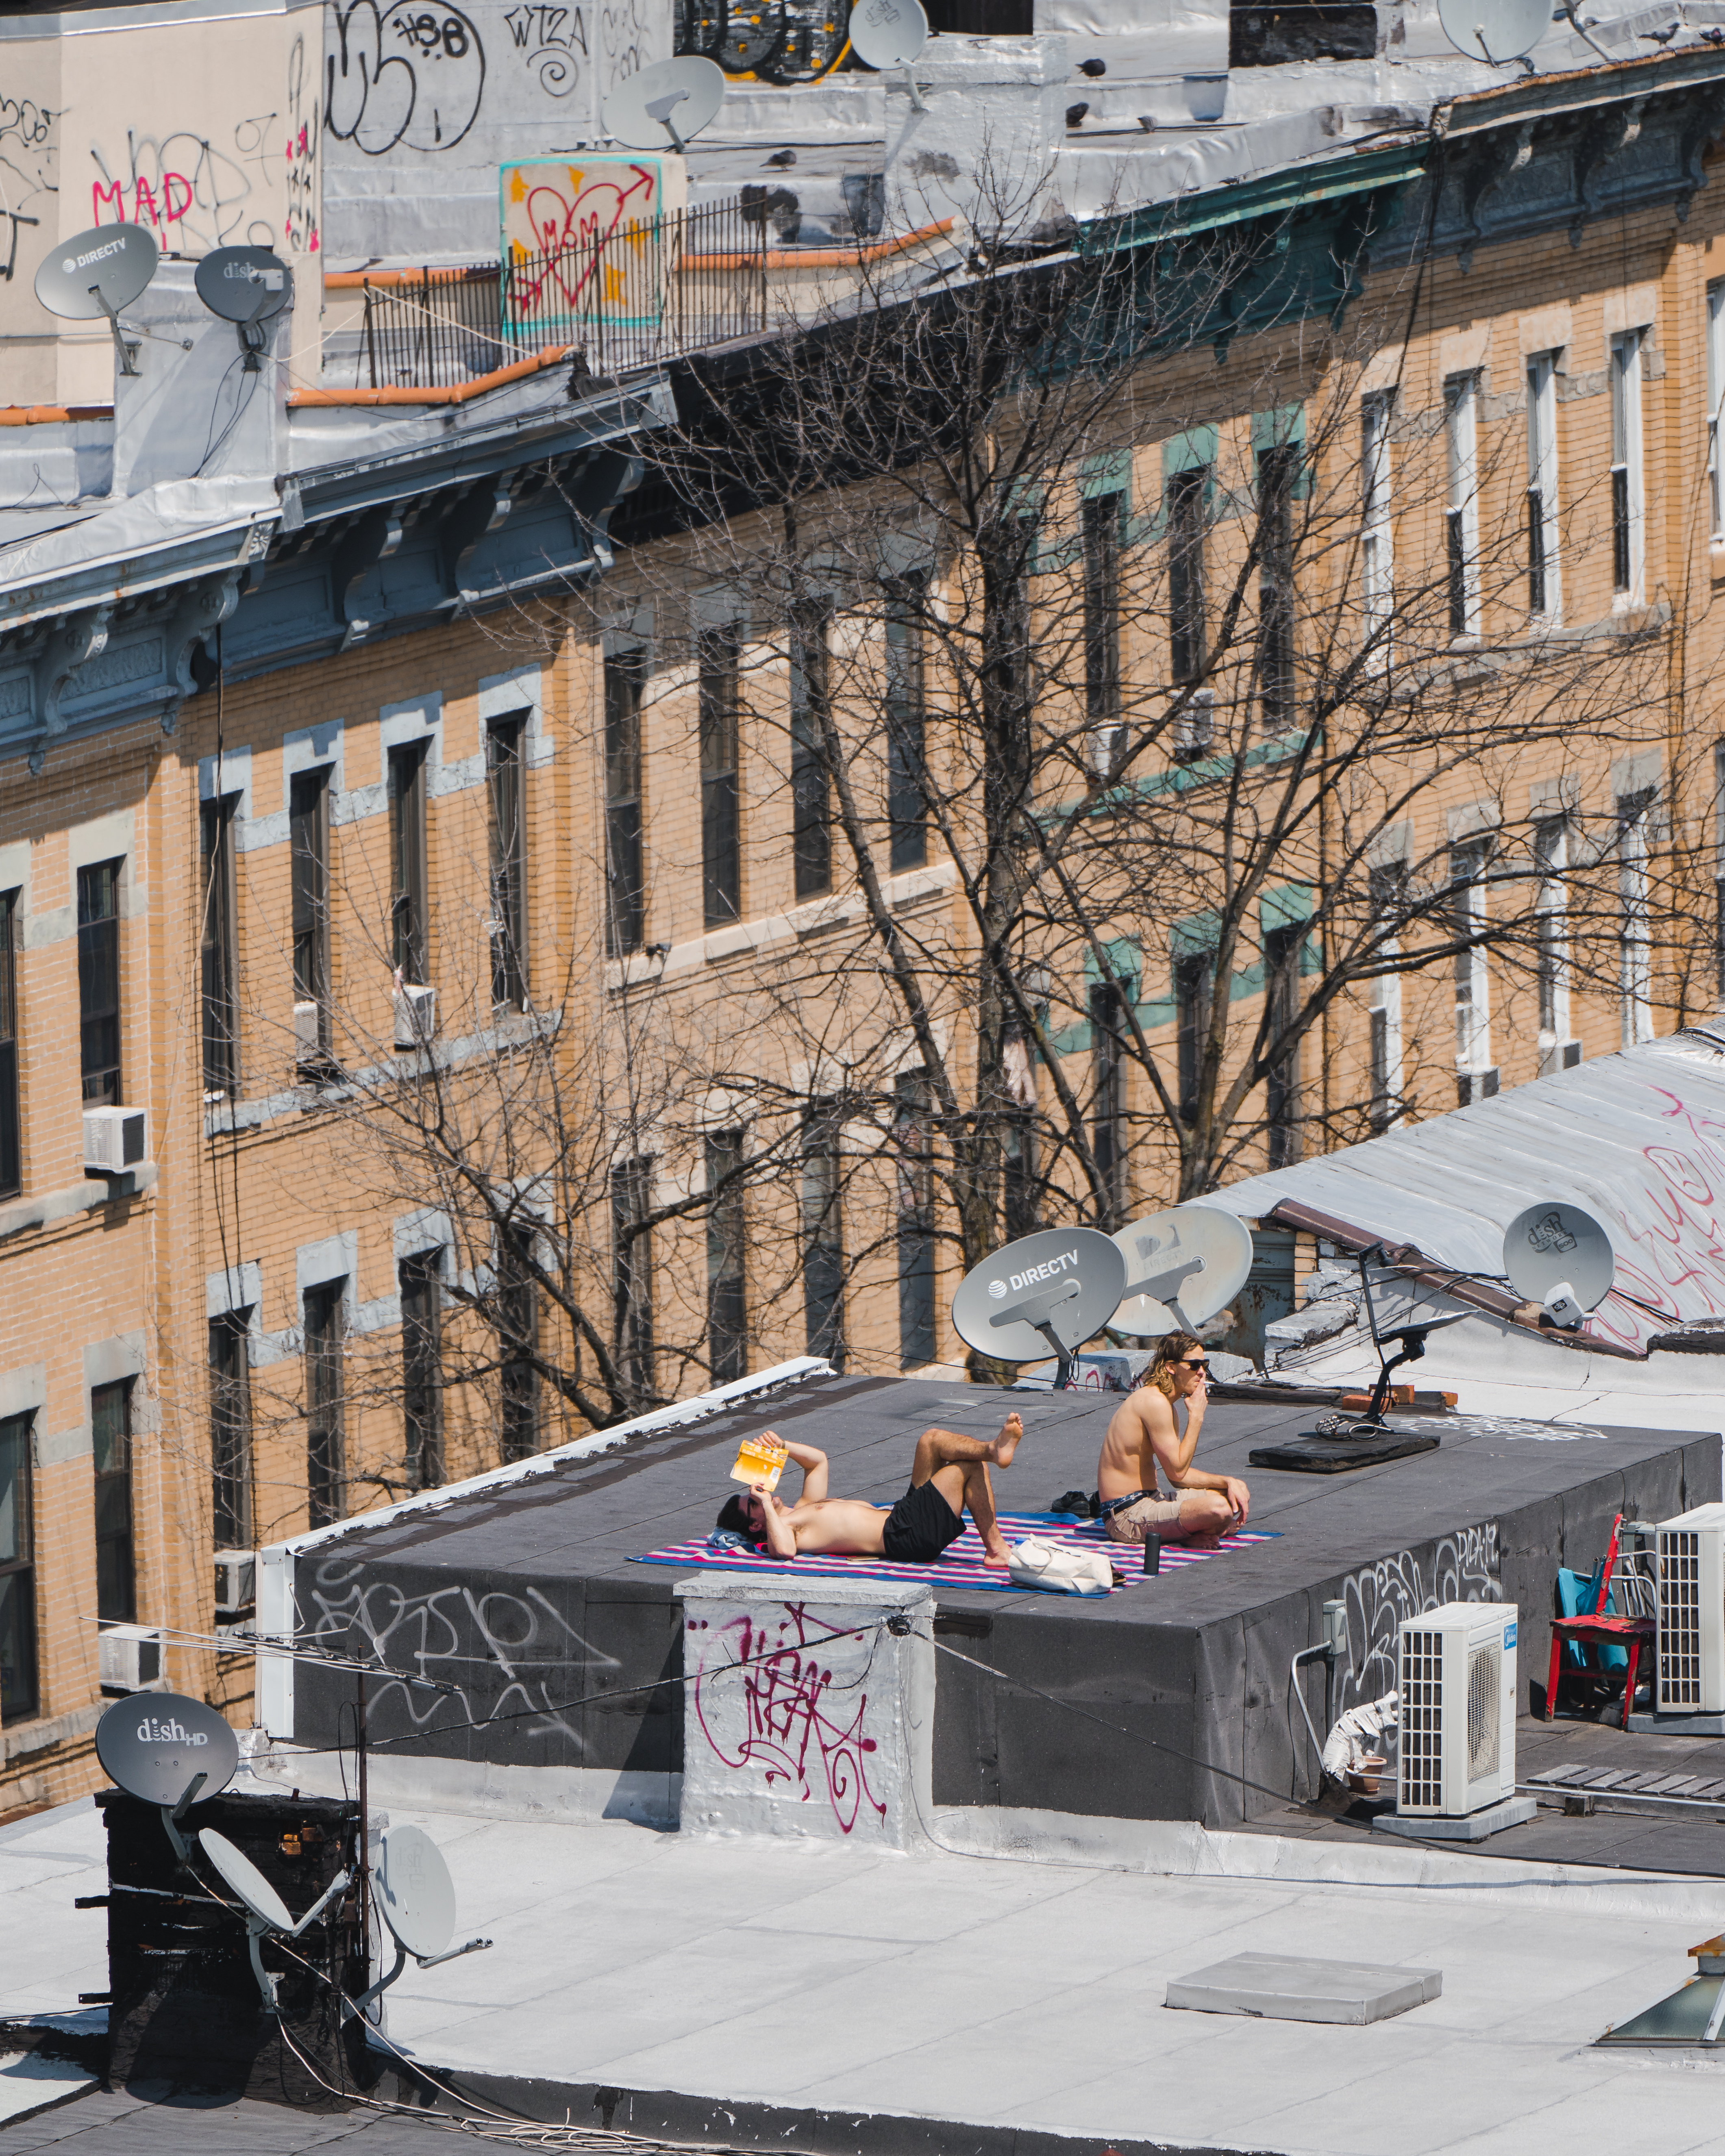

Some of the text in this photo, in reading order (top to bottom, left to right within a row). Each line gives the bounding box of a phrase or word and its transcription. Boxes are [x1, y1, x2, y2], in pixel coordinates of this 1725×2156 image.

[93, 172, 192, 227] MAD
[543, 210, 598, 253] MOM
[77, 237, 126, 267] DIRECTV
[1528, 1218, 1567, 1245] dish
[1558, 1239, 1573, 1249] 500
[1009, 1249, 1078, 1291] DIRECTV
[137, 1718, 208, 1746] dish HD
